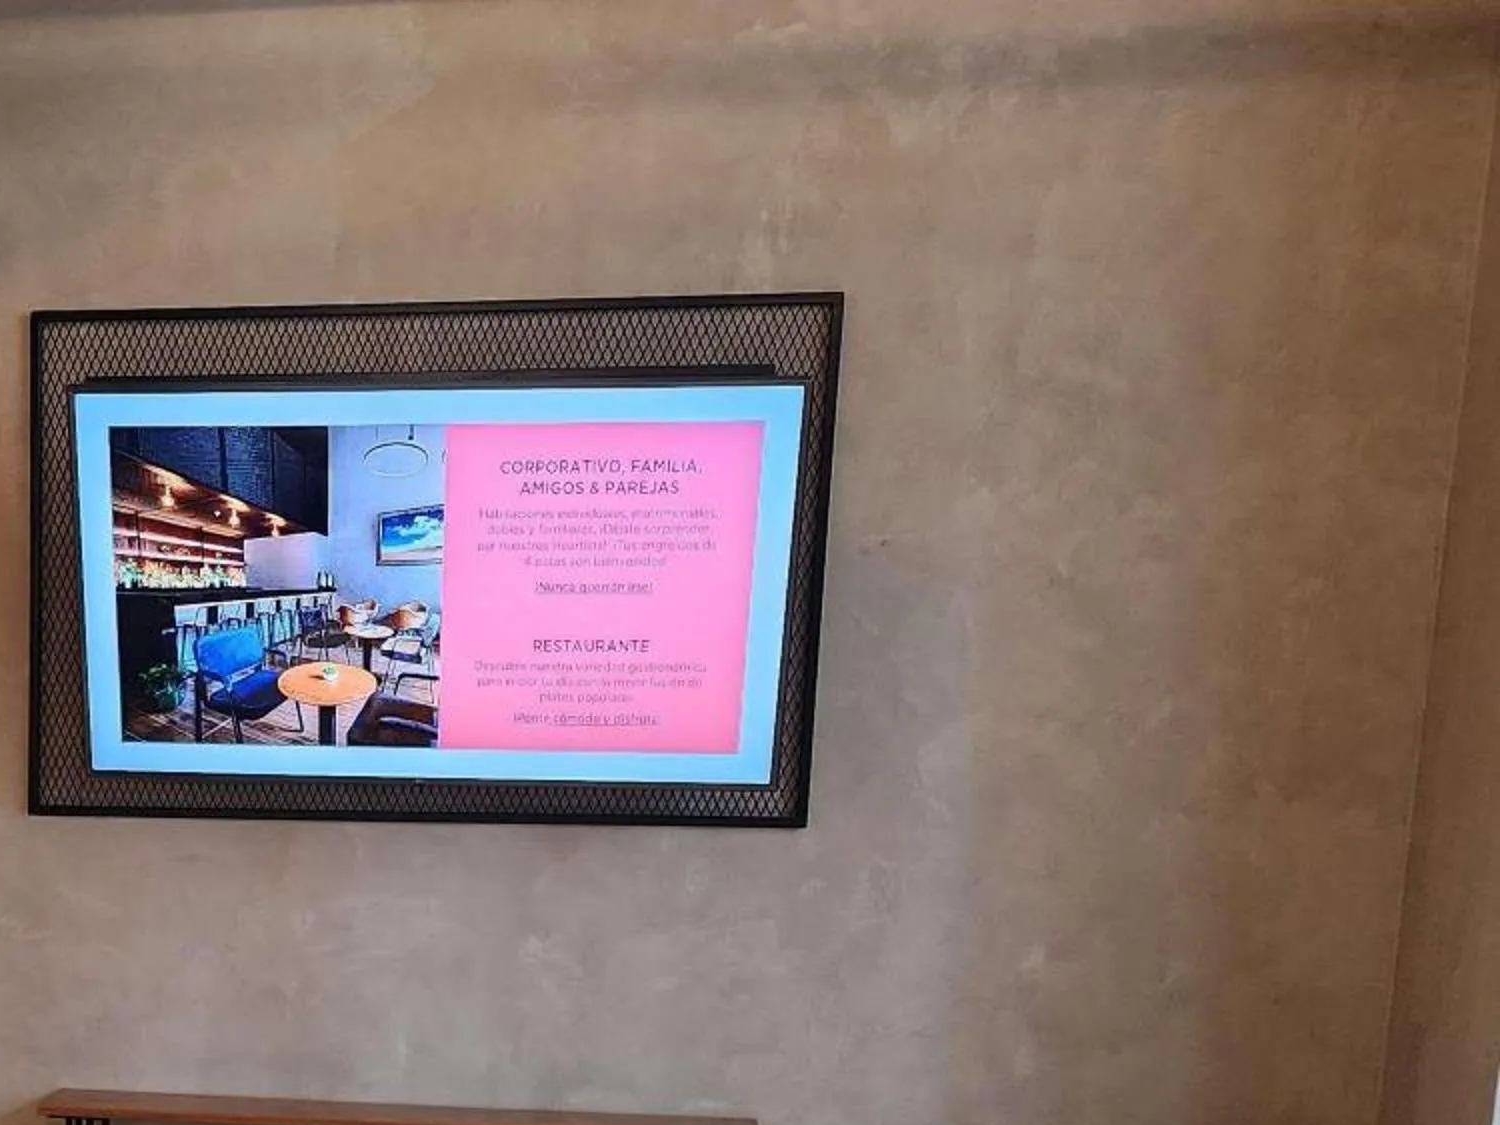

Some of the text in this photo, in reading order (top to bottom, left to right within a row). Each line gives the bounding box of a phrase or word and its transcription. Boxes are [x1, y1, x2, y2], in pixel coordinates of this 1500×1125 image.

[500, 459, 625, 475] CORPORATIVO,
[520, 480, 679, 495] AMIGOS & PAREJAS
[533, 639, 650, 653] RESTAURANTE
